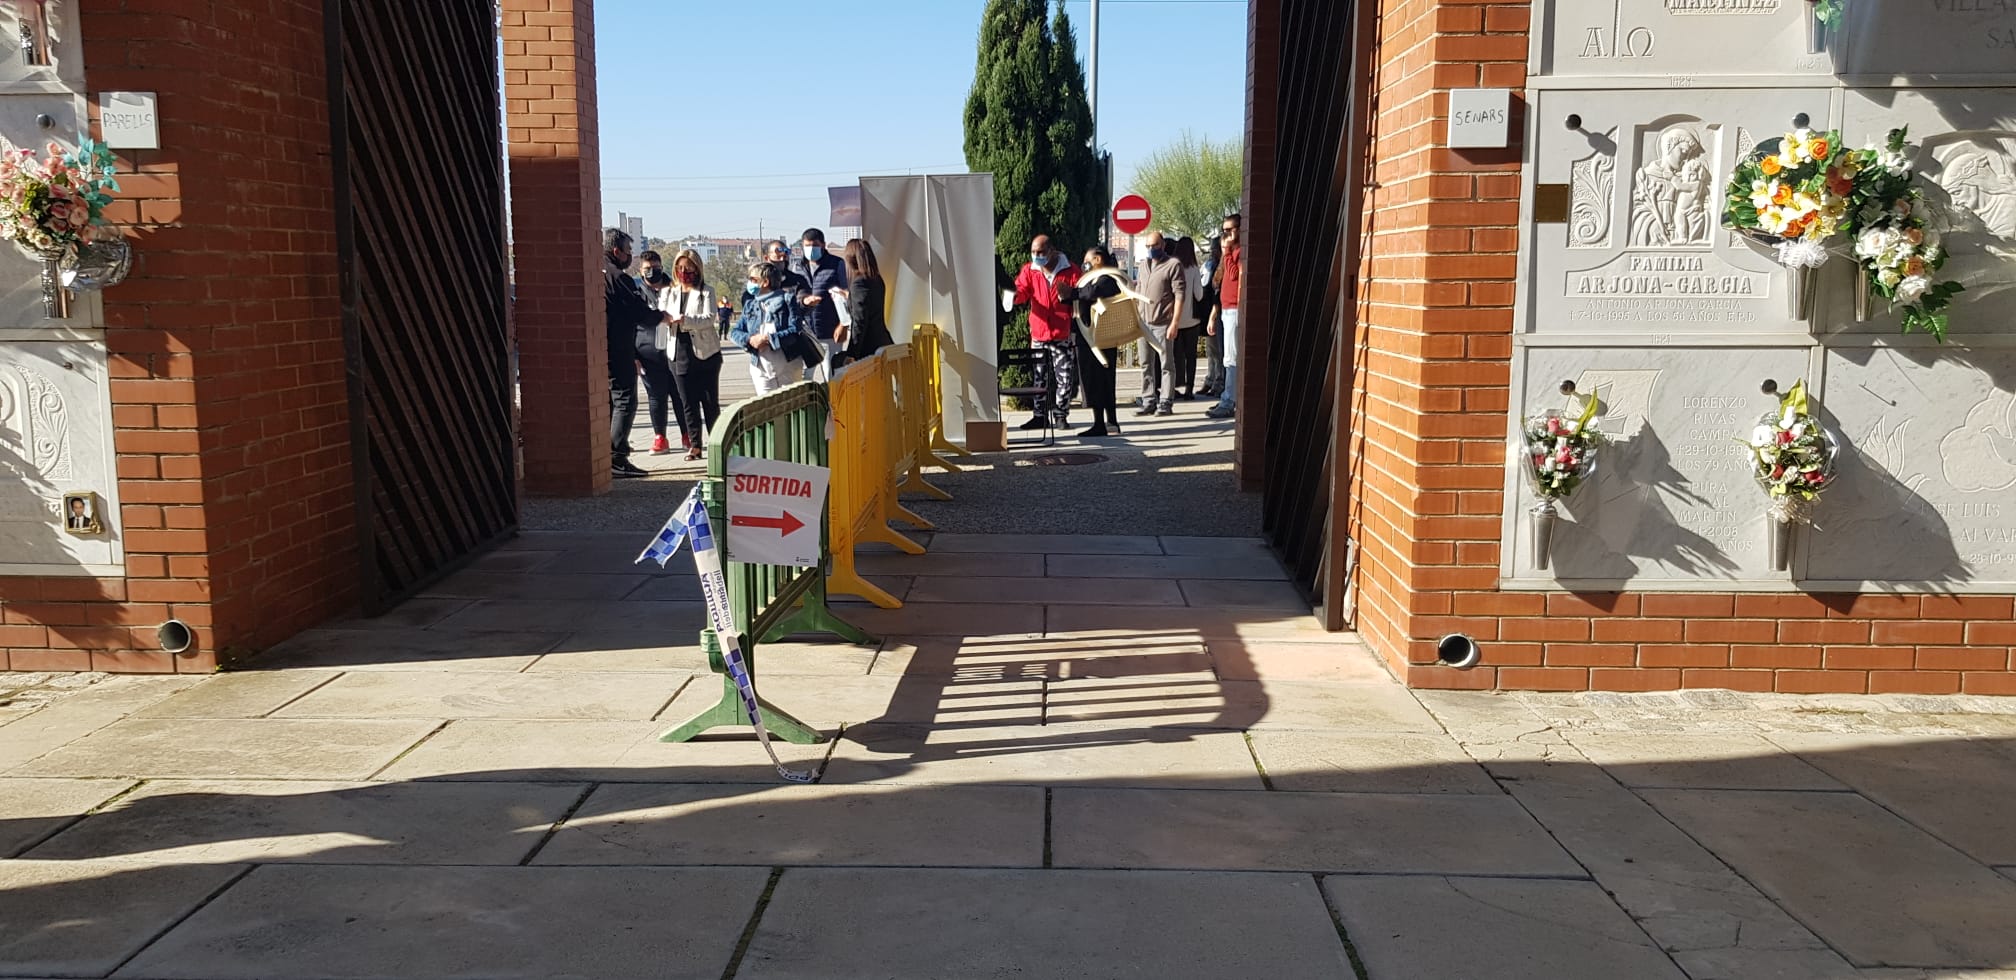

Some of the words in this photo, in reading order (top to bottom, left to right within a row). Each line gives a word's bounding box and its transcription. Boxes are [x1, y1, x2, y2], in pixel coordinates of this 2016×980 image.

[103, 112, 153, 130] PARELLS
[1455, 108, 1504, 126] SENARS
[1629, 256, 1704, 272] FAMILIA
[1577, 275, 1752, 294] ARJONA-GARCIA
[1585, 299, 1640, 309] ANTONIO
[1643, 299, 1694, 309] ARJONA
[1646, 311, 1667, 321] LOS
[1683, 396, 1747, 409] LORENZO
[1693, 412, 1737, 425] RIVAS
[1689, 429, 1738, 441] CAMPA
[1677, 460, 1701, 471] LOS
[1705, 460, 1719, 472] 79
[733, 473, 812, 498] SORTIDA
[1690, 481, 1728, 494] PURA
[1679, 511, 1737, 522] MARTIN
[1960, 503, 2001, 518] LUIS
[1718, 537, 1753, 551] AÑOS
